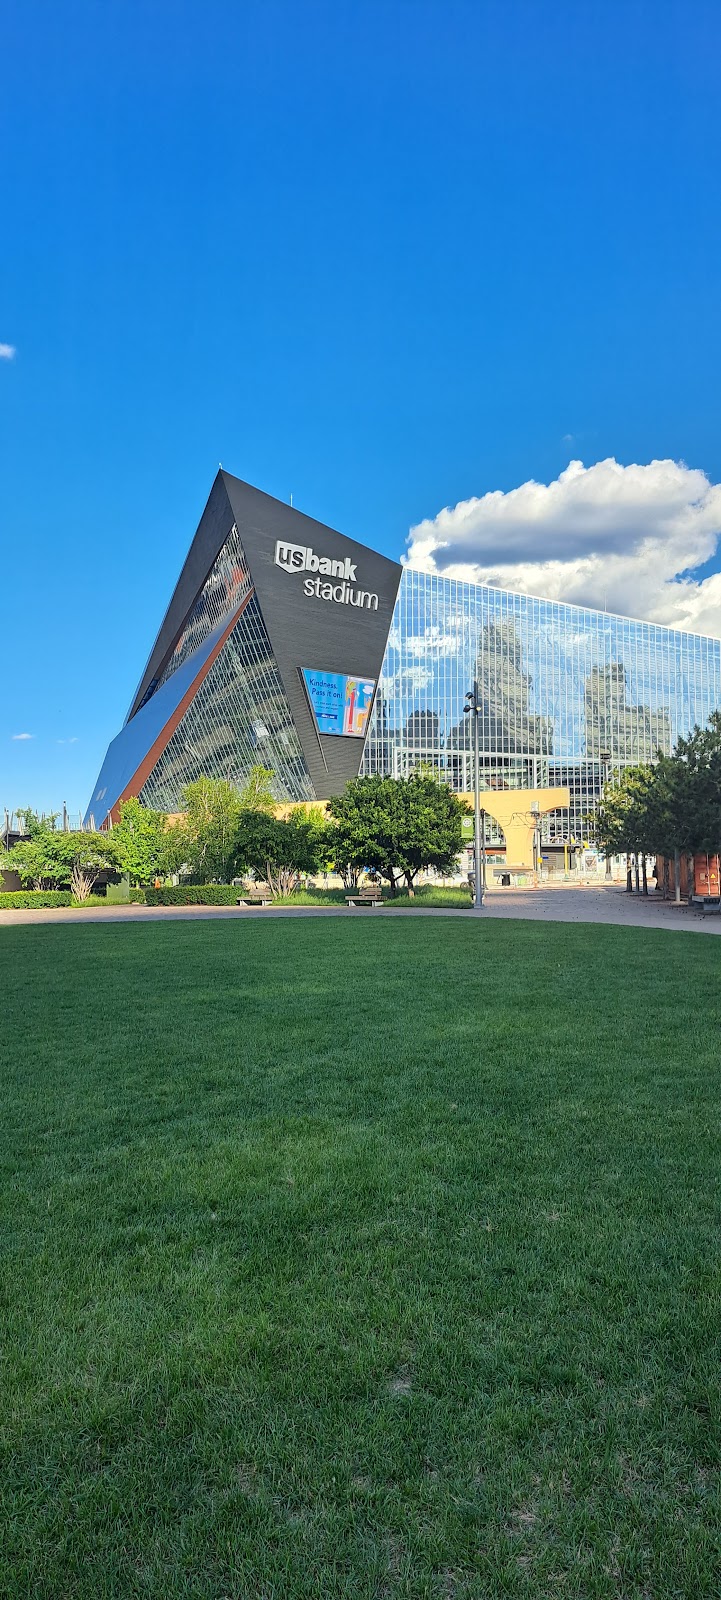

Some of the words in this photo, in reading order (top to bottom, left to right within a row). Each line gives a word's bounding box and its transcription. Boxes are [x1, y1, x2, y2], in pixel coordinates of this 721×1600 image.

[303, 576, 379, 611] stadium
[310, 678, 338, 689] Kindness.
[312, 688, 326, 696] Pass
